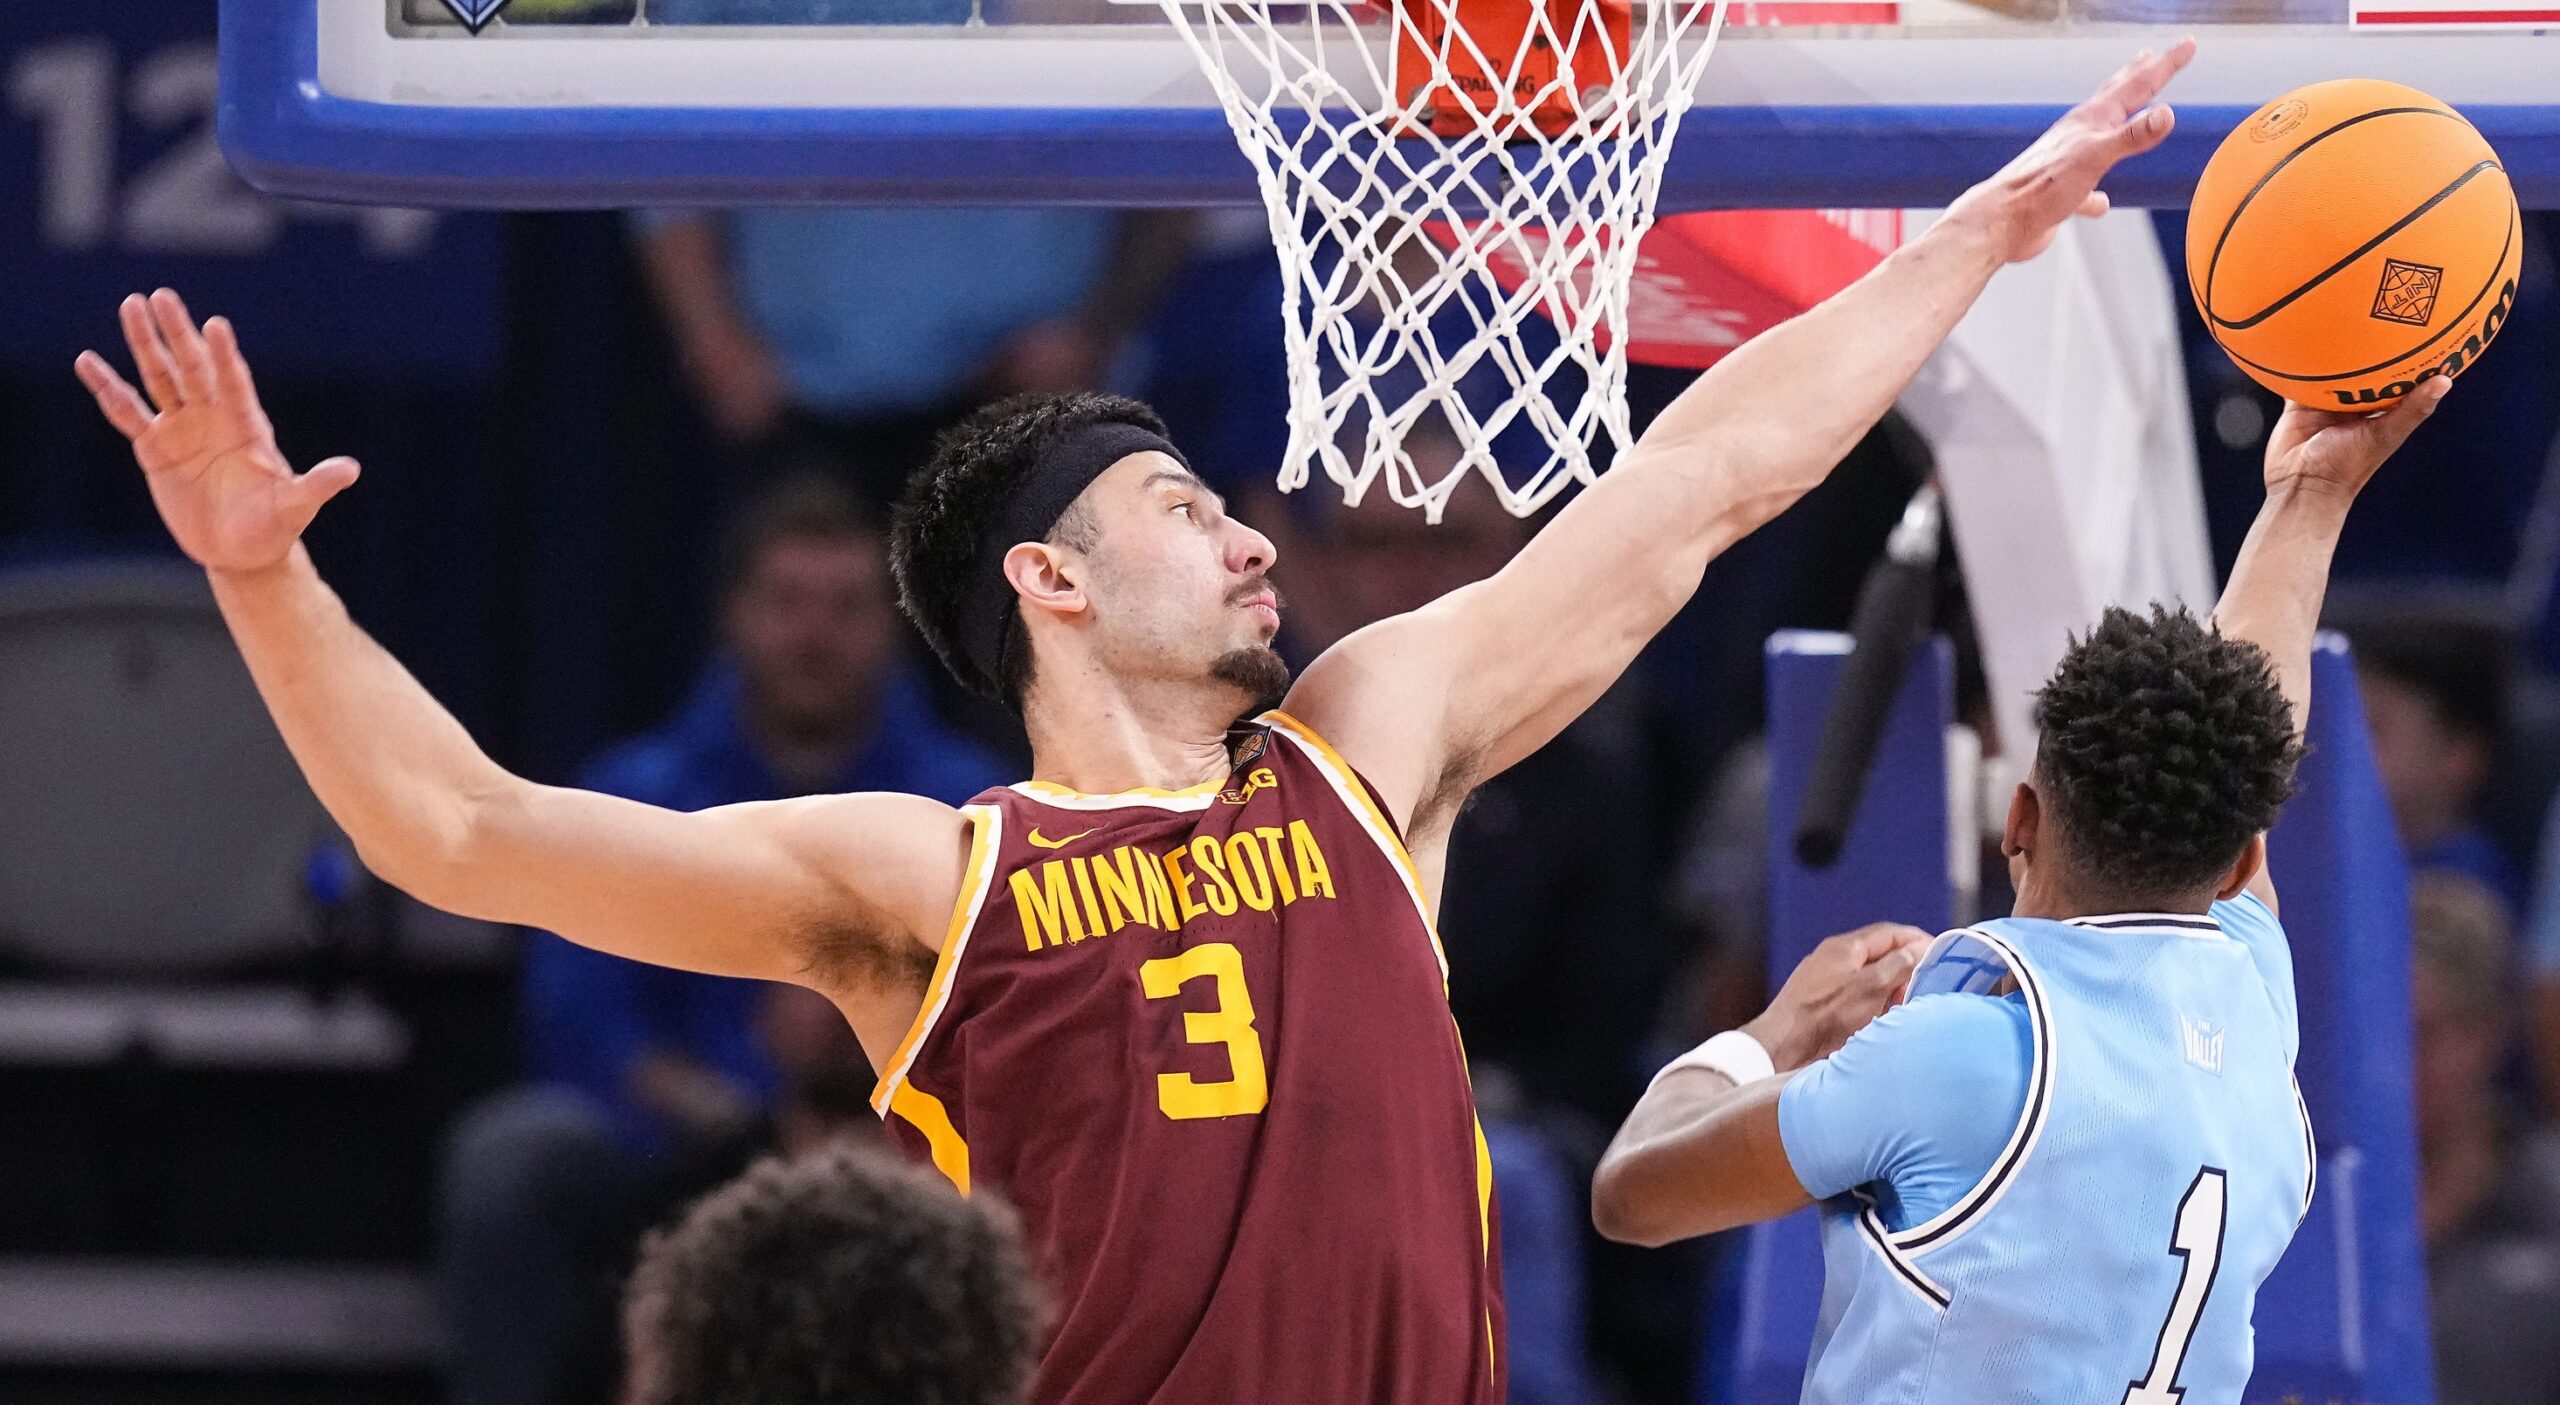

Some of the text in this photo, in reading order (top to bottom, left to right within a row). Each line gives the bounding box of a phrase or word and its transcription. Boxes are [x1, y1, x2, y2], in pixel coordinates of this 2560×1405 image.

[8, 40, 438, 252] 12
[1449, 75, 1535, 95] PALNG
[2391, 277, 2430, 310] NIT
[1008, 819, 1337, 952] MINNESOTA
[1139, 942, 1268, 1120] 3
[2180, 1014, 2225, 1073] VALLEY
[2120, 1165, 2228, 1405] 1
